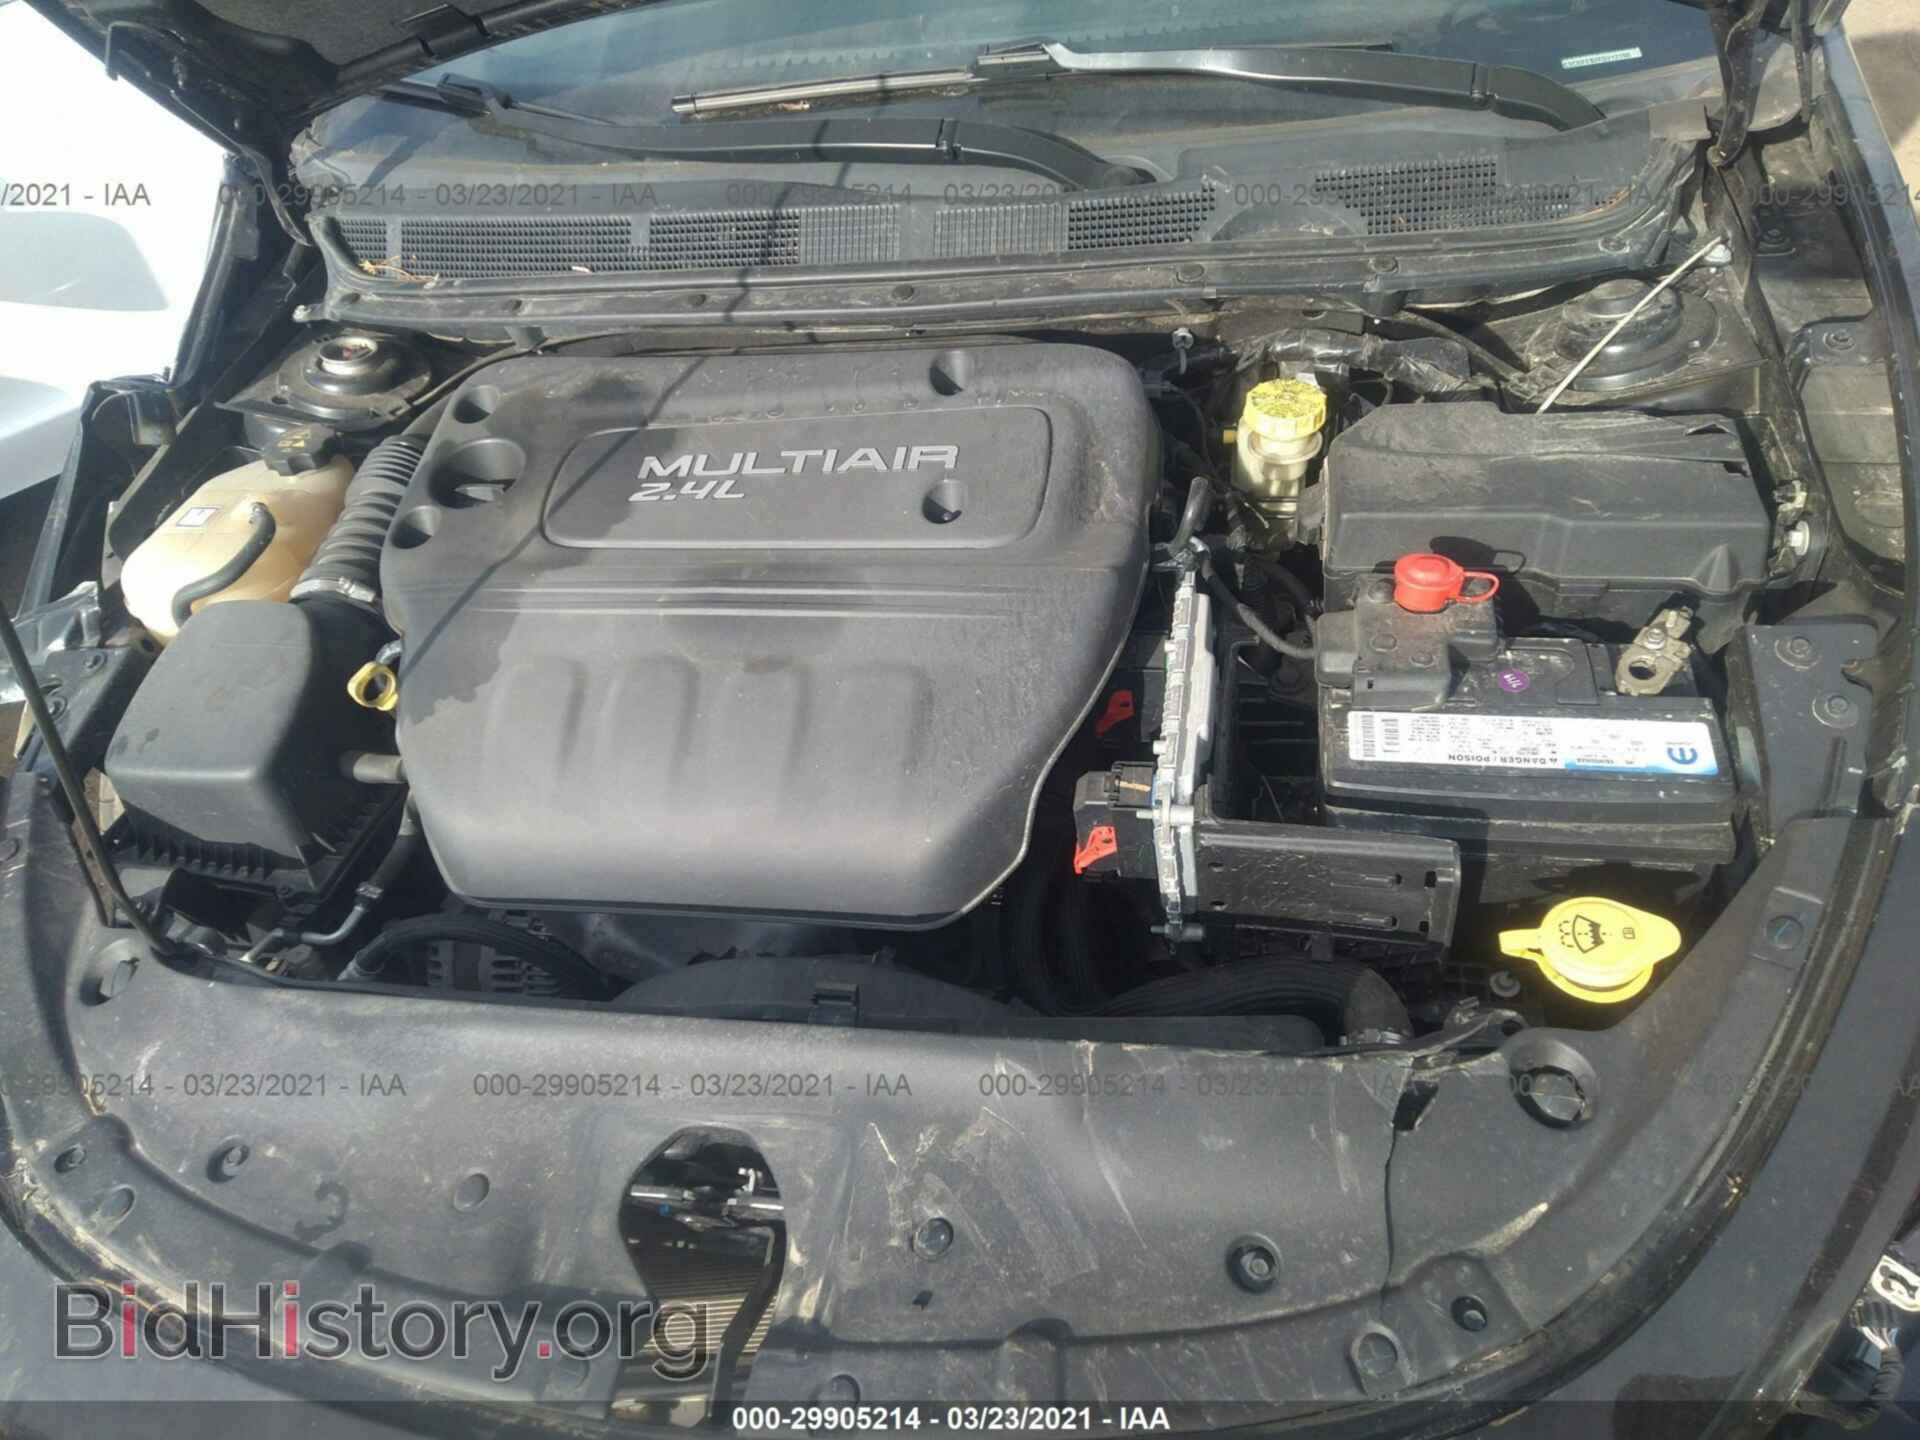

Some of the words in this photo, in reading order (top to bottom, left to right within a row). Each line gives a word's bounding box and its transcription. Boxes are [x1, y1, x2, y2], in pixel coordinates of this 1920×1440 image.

[637, 444, 960, 479] MULTIAIR
[628, 479, 746, 502] 2.4L
[1449, 753, 1490, 763] POISON
